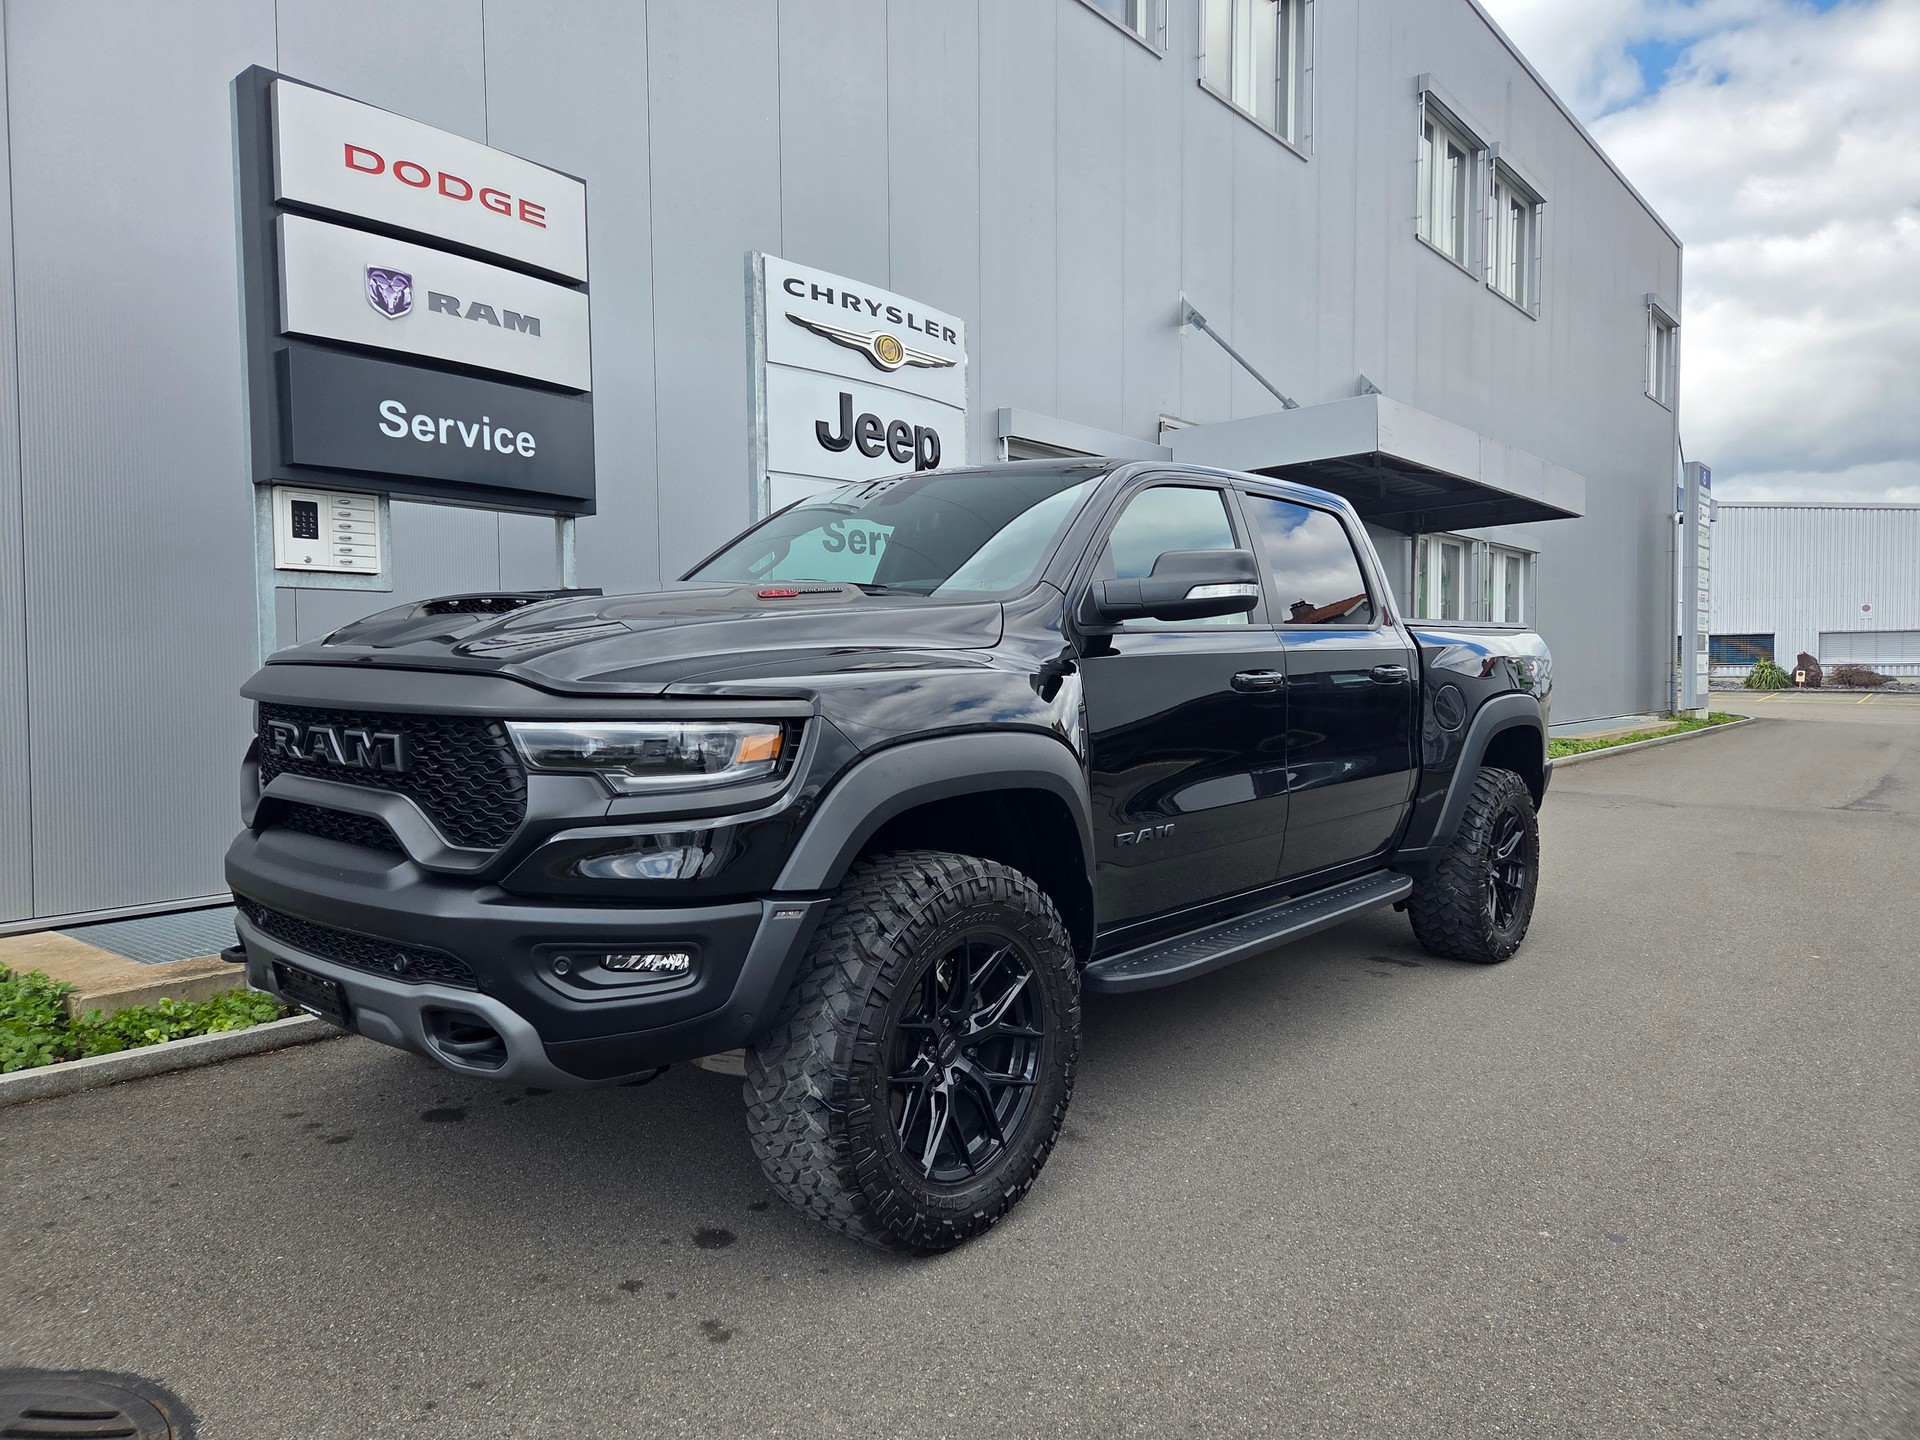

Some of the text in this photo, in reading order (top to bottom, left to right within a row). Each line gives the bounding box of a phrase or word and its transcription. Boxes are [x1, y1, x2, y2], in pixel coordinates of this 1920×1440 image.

[344, 142, 547, 229] DODGE
[427, 290, 541, 338] RAM
[782, 277, 958, 346] CHRYSLER
[378, 399, 537, 458] Service
[815, 391, 941, 472] Jeep
[267, 719, 404, 771] RAM
[1114, 823, 1175, 847] RAM
